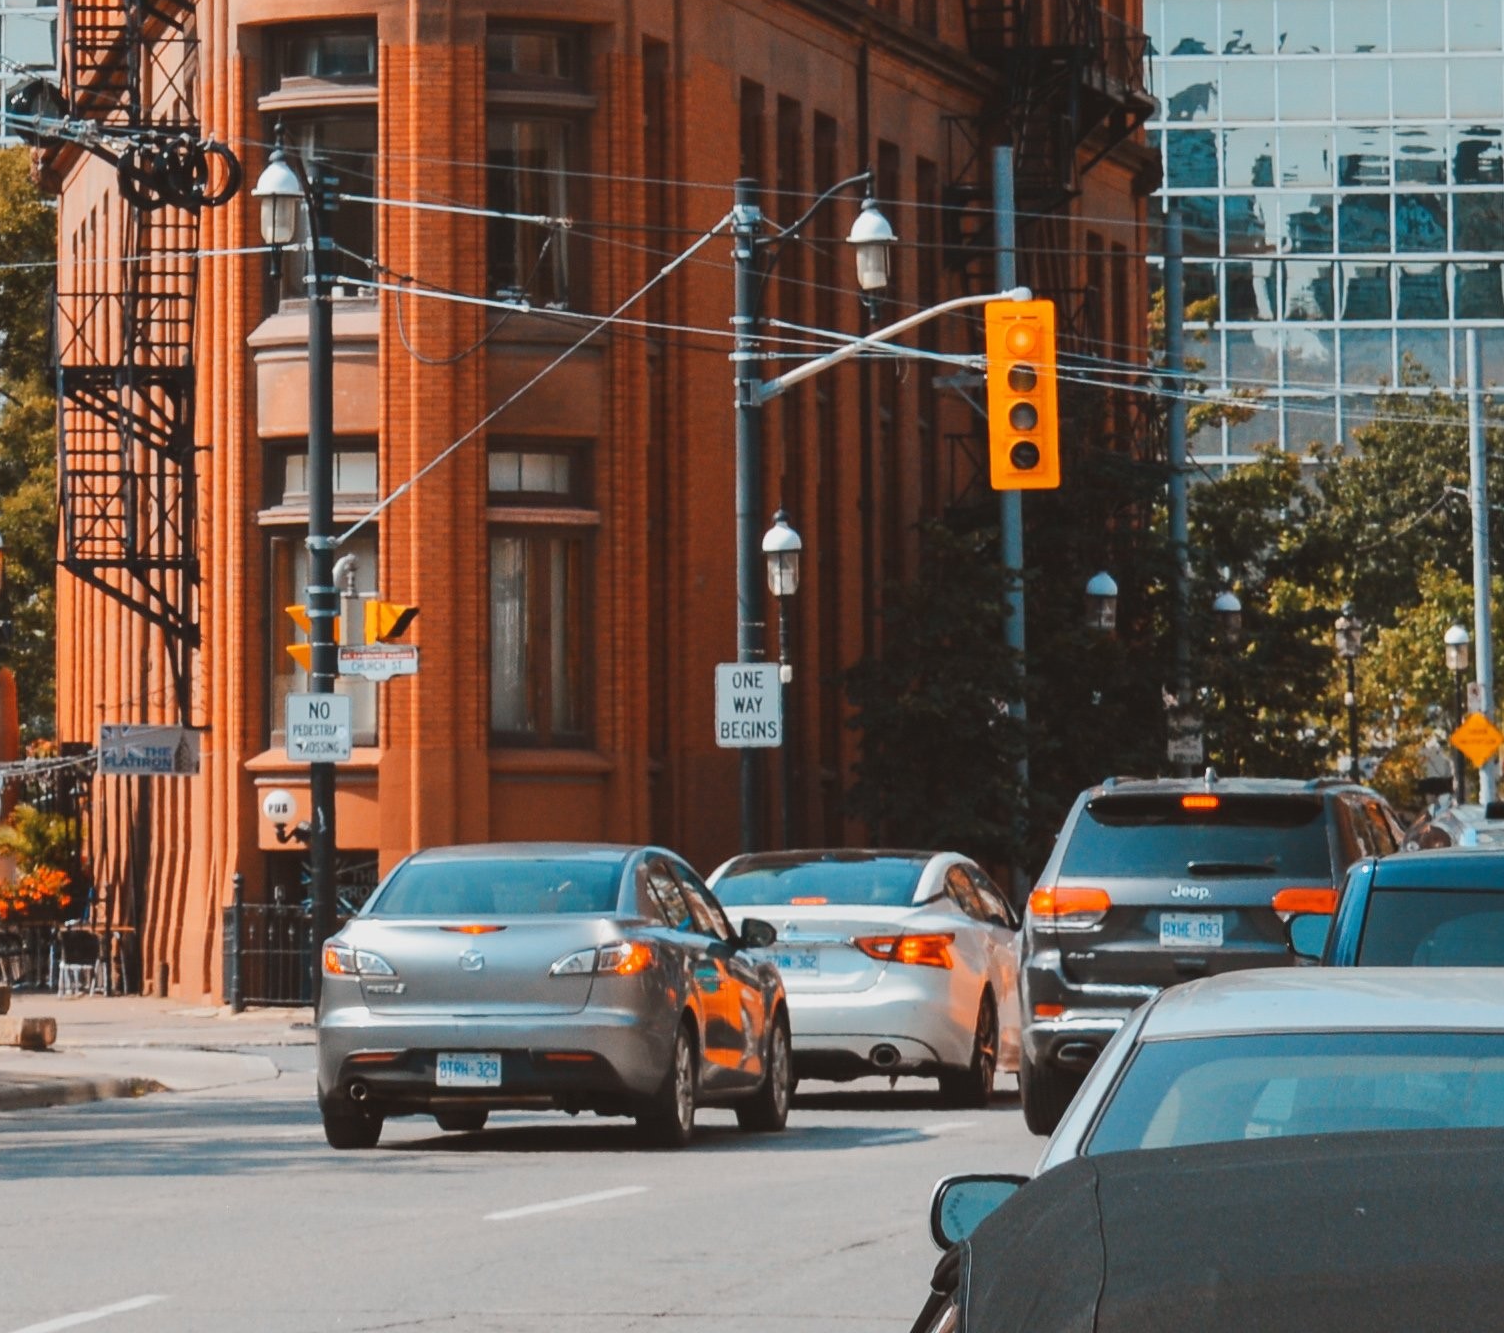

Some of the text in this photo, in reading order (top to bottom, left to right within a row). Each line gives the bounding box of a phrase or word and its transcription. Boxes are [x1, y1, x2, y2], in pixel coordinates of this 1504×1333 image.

[732, 671, 764, 689] ONE
[309, 701, 330, 719] NO
[733, 696, 763, 714] WAY
[720, 721, 777, 740] BEGINS
[268, 803, 288, 813] PUB
[1171, 884, 1209, 900] Jeep
